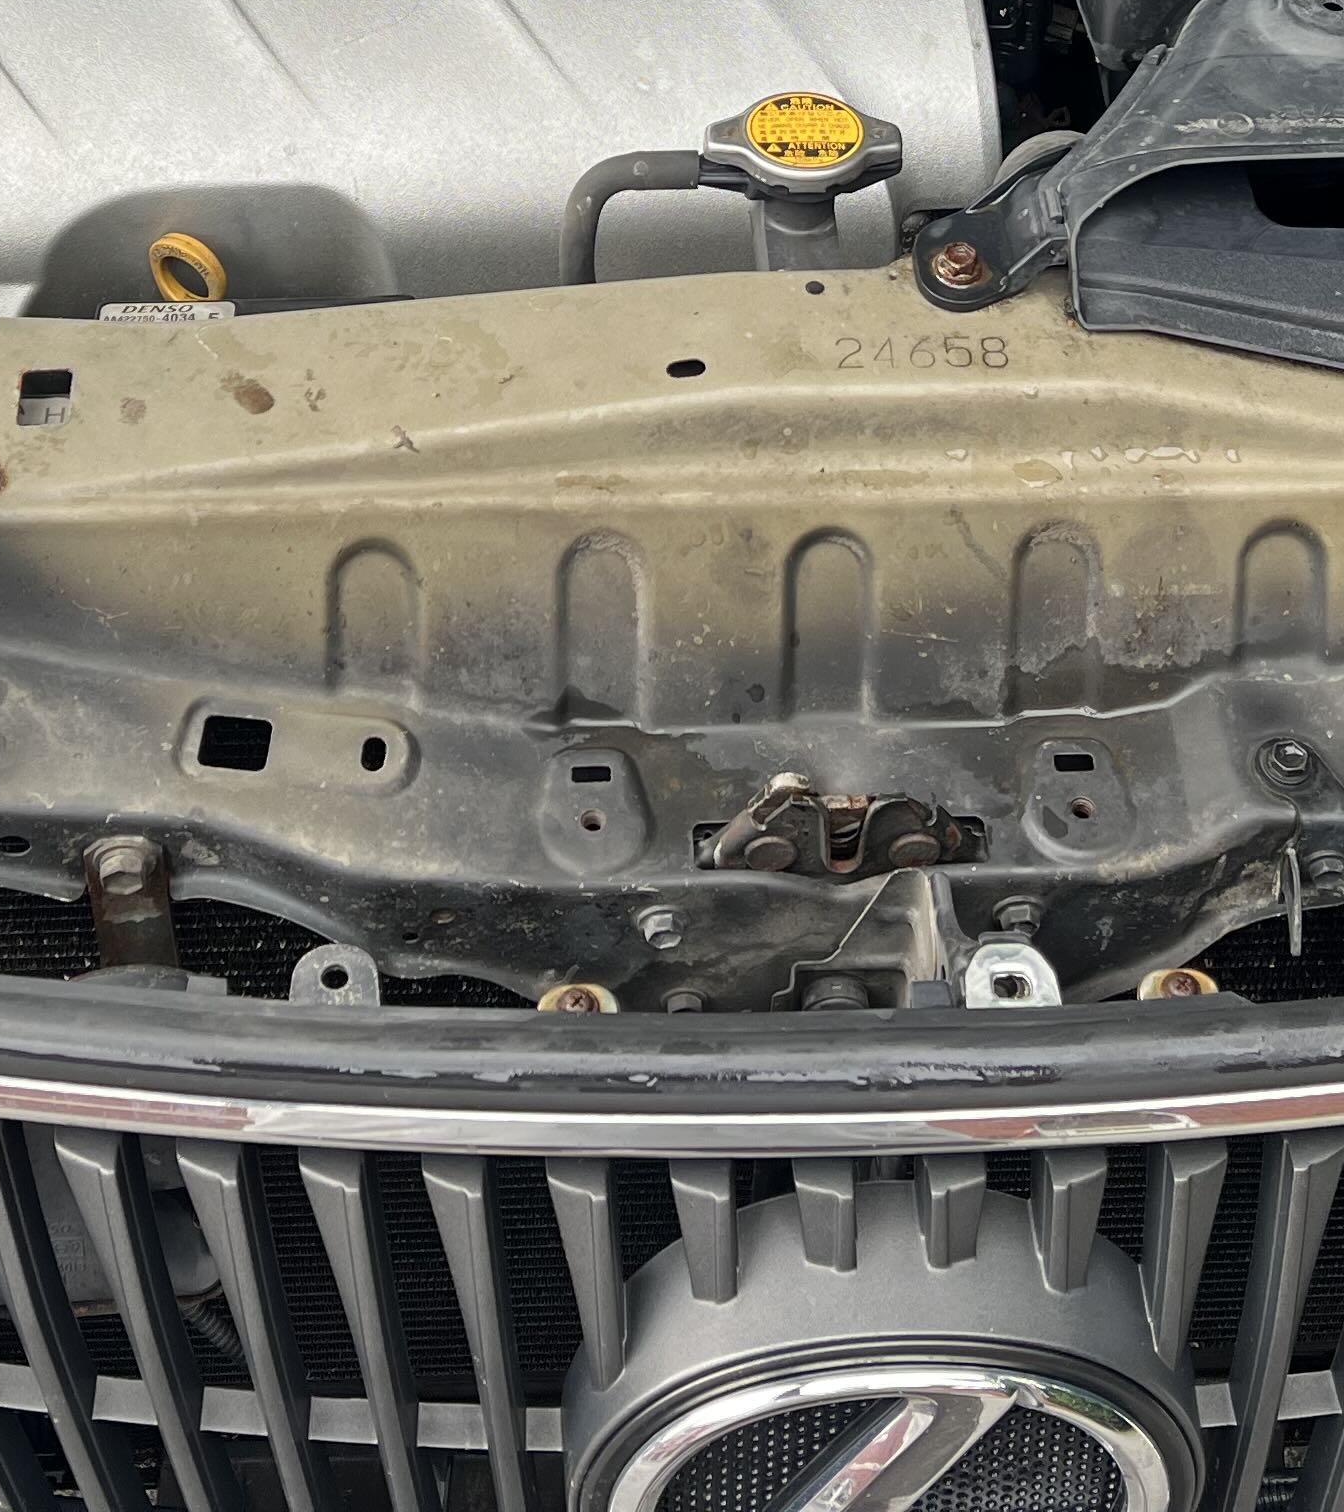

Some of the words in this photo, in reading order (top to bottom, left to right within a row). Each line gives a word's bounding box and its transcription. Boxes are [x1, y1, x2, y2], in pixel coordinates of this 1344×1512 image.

[788, 142, 846, 150] ATTENTION
[121, 304, 194, 314] DENSO
[834, 335, 1009, 369] 24658
